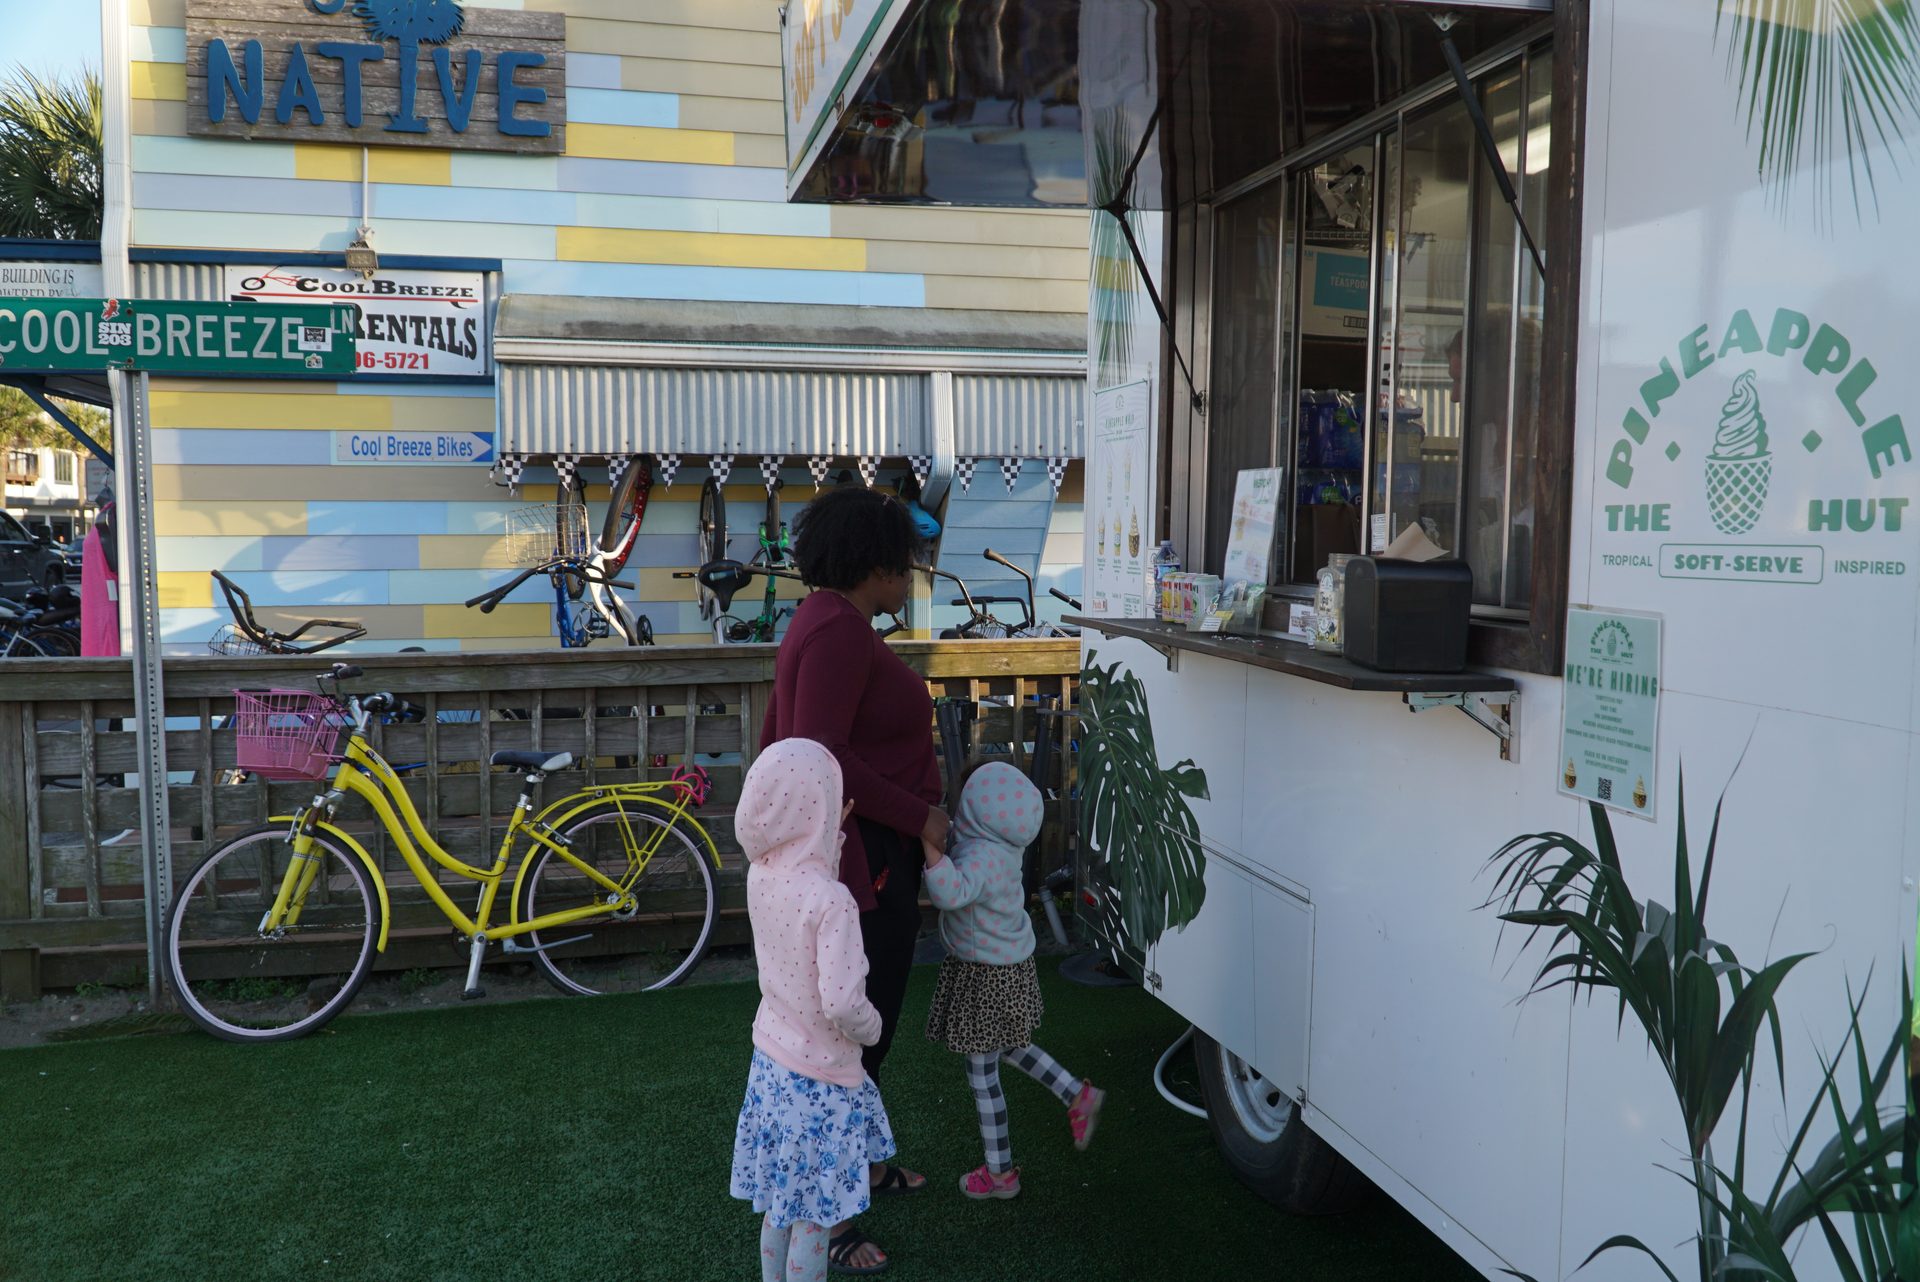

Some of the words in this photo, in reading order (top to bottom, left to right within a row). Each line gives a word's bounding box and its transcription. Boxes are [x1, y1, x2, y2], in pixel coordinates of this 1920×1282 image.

[207, 38, 553, 138] NATIVE
[2, 268, 60, 284] BUILDING
[63, 268, 75, 285] IS
[0, 308, 109, 355] COOL
[136, 313, 305, 360] BREEZE
[330, 309, 355, 334] LN
[97, 321, 132, 334] SIN
[97, 333, 132, 346] 203
[1606, 307, 1912, 489] PINEAPPLE
[351, 435, 382, 456] Cool
[387, 436, 433, 457] Breeze
[437, 436, 474, 458] Bikes
[1605, 503, 1671, 532] THE
[1808, 497, 1909, 532] HUT
[1602, 553, 1653, 568] TROPICAL
[1674, 553, 1804, 575] SOFT-SERVE
[1834, 559, 1906, 576] INSPIRED
[1566, 663, 1604, 689] WE'RE
[1611, 671, 1658, 698] HIRING
